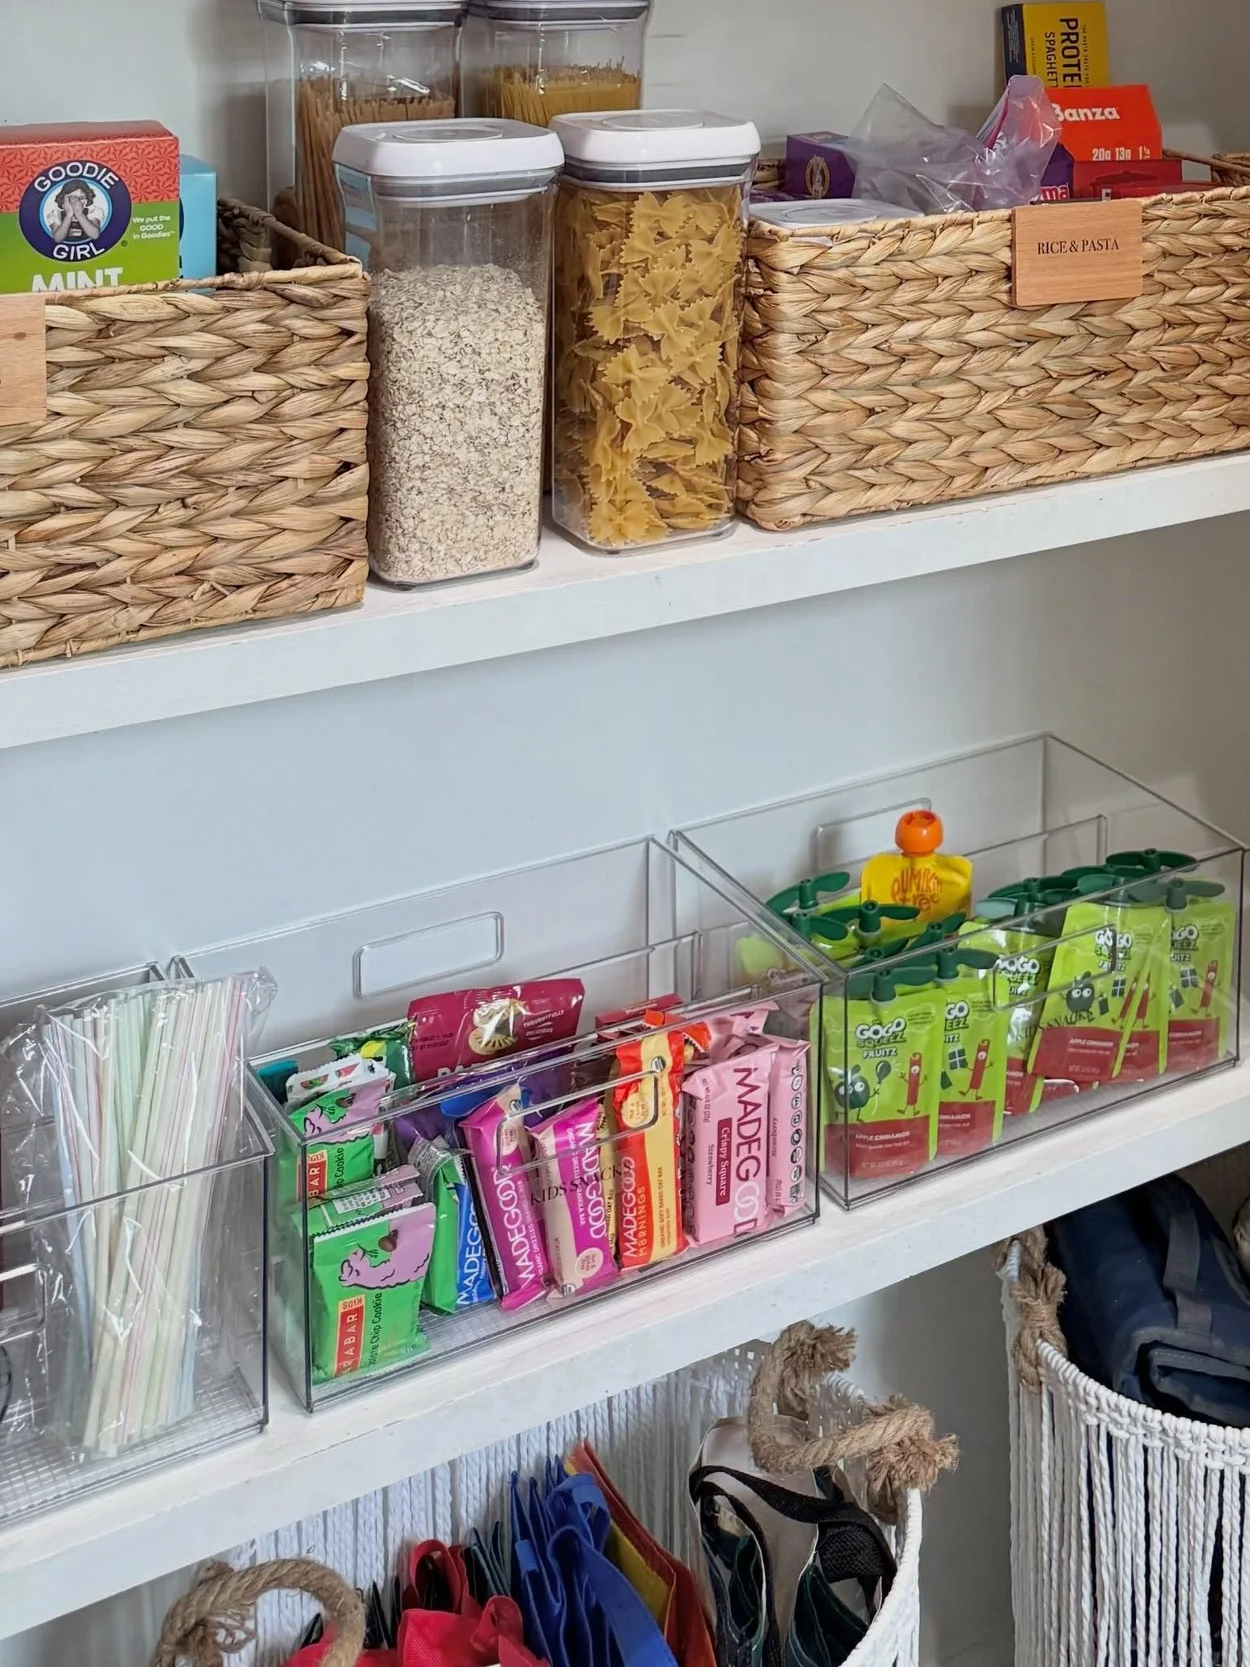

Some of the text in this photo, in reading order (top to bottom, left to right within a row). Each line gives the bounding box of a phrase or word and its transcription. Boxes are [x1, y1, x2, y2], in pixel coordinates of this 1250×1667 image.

[34, 162, 119, 192] GOODIE
[139, 223, 164, 232] GOOD
[145, 216, 158, 224] put
[159, 214, 171, 222] the
[52, 242, 105, 260] GIRL
[1037, 238, 1120, 255] RICE & PASTA
[31, 267, 124, 293] MINT
[862, 1047, 898, 1060] FRUITZ
[855, 1130, 911, 1143] APPLE CINNAMON
[718, 1126, 730, 1198] Crispy Square
[733, 1067, 763, 1238] MADEGOOD
[705, 1143, 715, 1186] Strawberry
[530, 1184, 568, 1207] KIDS
[621, 1155, 638, 1258] MADEGOOD
[341, 1296, 364, 1310] KIDS
[372, 1292, 383, 1327] Cookie
